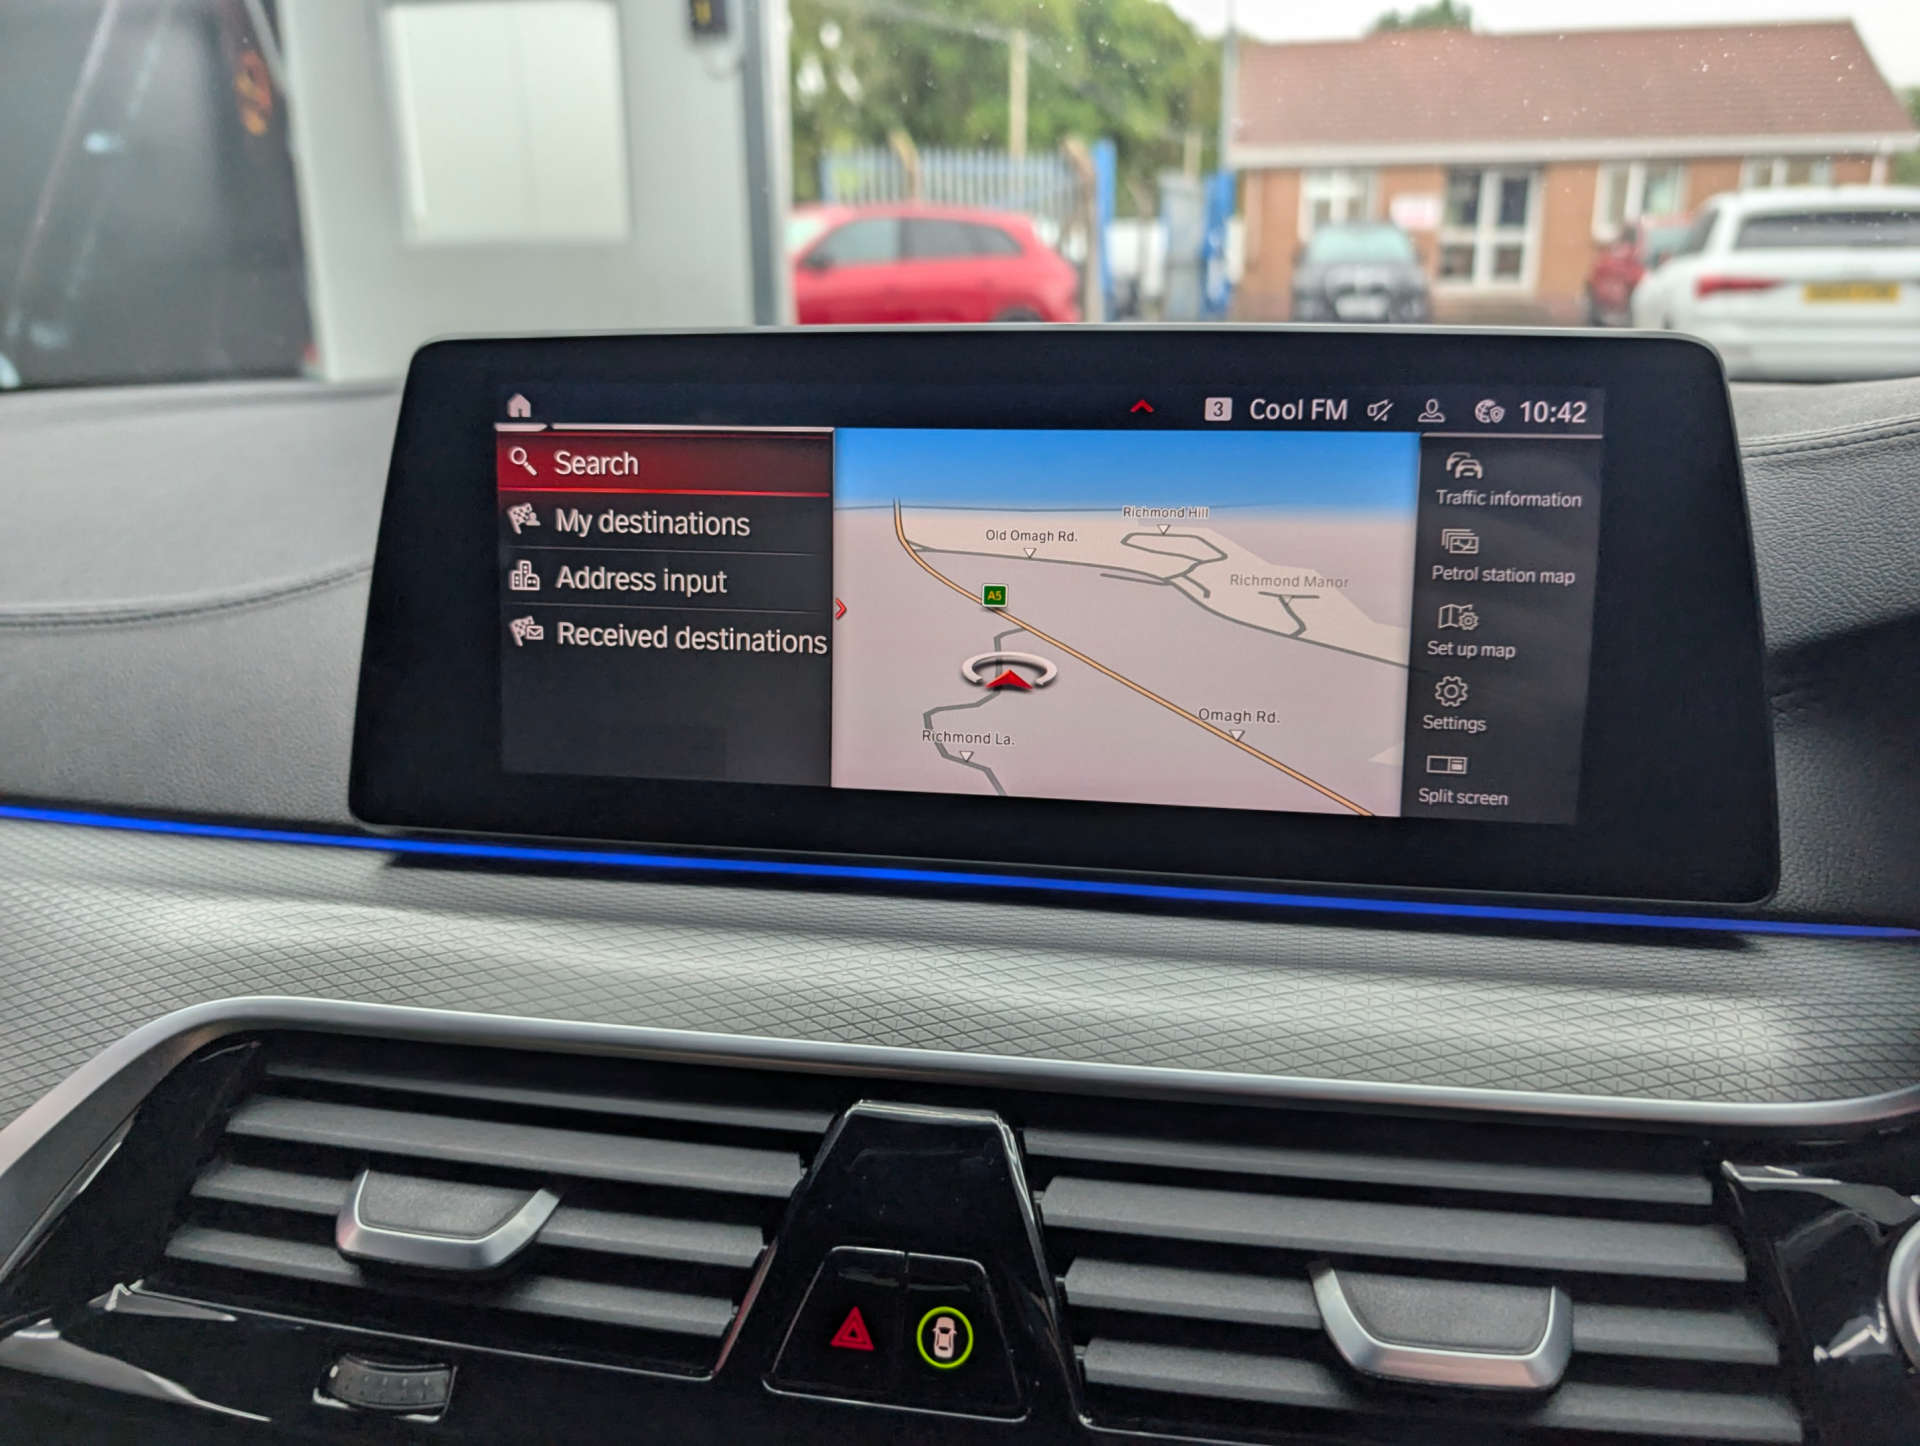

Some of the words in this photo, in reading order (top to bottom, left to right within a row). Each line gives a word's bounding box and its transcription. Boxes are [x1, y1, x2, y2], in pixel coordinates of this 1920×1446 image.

[1213, 402, 1224, 418] 3
[1249, 398, 1302, 420] Cool
[1311, 399, 1348, 421] FM
[1520, 401, 1587, 424] 10:42
[553, 450, 639, 476] Search
[1436, 489, 1485, 507] Traffic
[1489, 491, 1582, 509] information
[555, 508, 592, 537] My
[599, 510, 750, 537] destinations
[1122, 506, 1186, 520] Richmond
[1189, 506, 1209, 519] Hill
[985, 529, 1006, 543] Old
[1010, 529, 1054, 544] Omagh
[1057, 530, 1078, 543] Rd.
[555, 566, 656, 591] Address
[663, 568, 728, 598] input
[1229, 574, 1300, 588] Richmond
[1304, 575, 1349, 589] Manor
[1432, 565, 1479, 582] Petrol
[1482, 567, 1536, 583] station
[1539, 569, 1576, 587] map
[987, 590, 1002, 601] A5
[557, 622, 668, 649] Received
[675, 625, 828, 654] destinations
[1427, 640, 1454, 656] Set
[1457, 643, 1478, 659] up
[1481, 644, 1516, 660] map
[1199, 708, 1254, 725] Omagh
[1257, 708, 1280, 723] Rd.
[1423, 714, 1487, 734] Settings
[922, 729, 990, 745] Richmond
[995, 731, 1015, 746] La.
[1419, 787, 1454, 805] Split
[1457, 791, 1509, 806] screen
